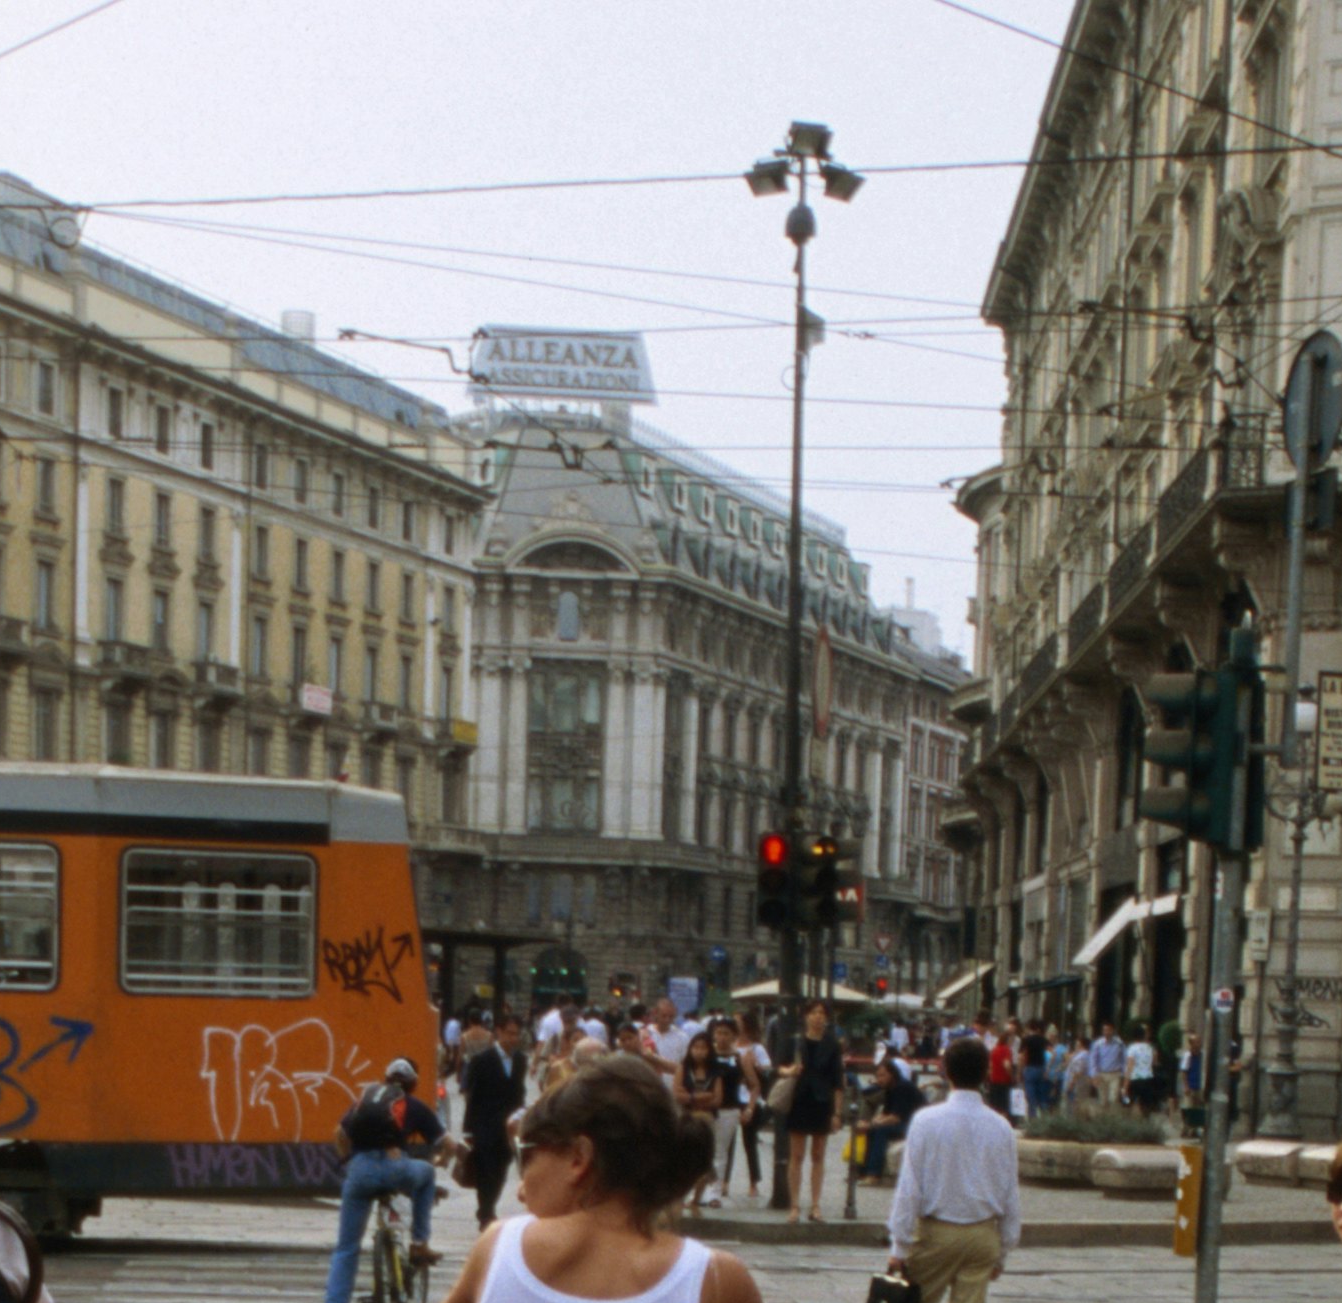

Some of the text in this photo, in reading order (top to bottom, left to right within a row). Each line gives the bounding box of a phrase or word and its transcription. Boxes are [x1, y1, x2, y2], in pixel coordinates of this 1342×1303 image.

[488, 338, 638, 369] ALLEANZA
[489, 368, 640, 391] ASSICURAZIONI
[1323, 680, 1336, 693] LA
